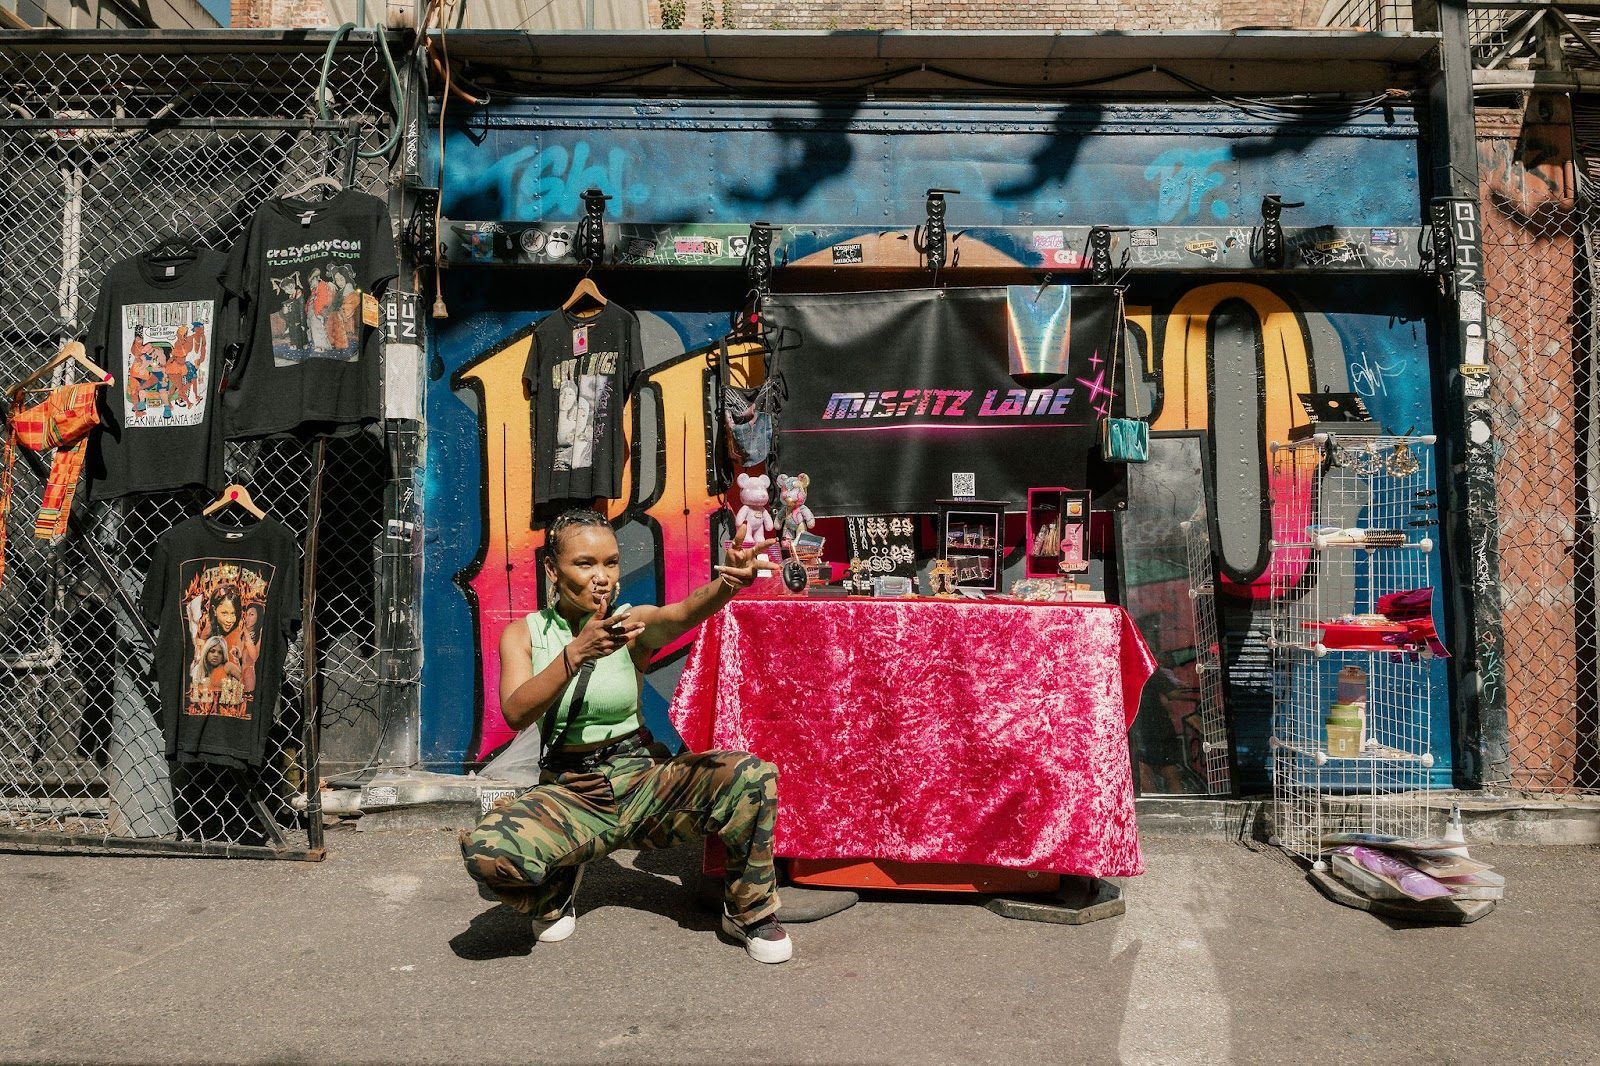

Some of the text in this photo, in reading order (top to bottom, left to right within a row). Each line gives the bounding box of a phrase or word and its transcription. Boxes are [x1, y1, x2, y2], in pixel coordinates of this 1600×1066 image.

[331, 250, 360, 259] TOUR
[126, 304, 158, 330] WHO
[161, 302, 189, 326] DAT
[977, 387, 1075, 417] LANE
[847, 516, 859, 558] WONDER
[857, 516, 868, 550] WOMAN
